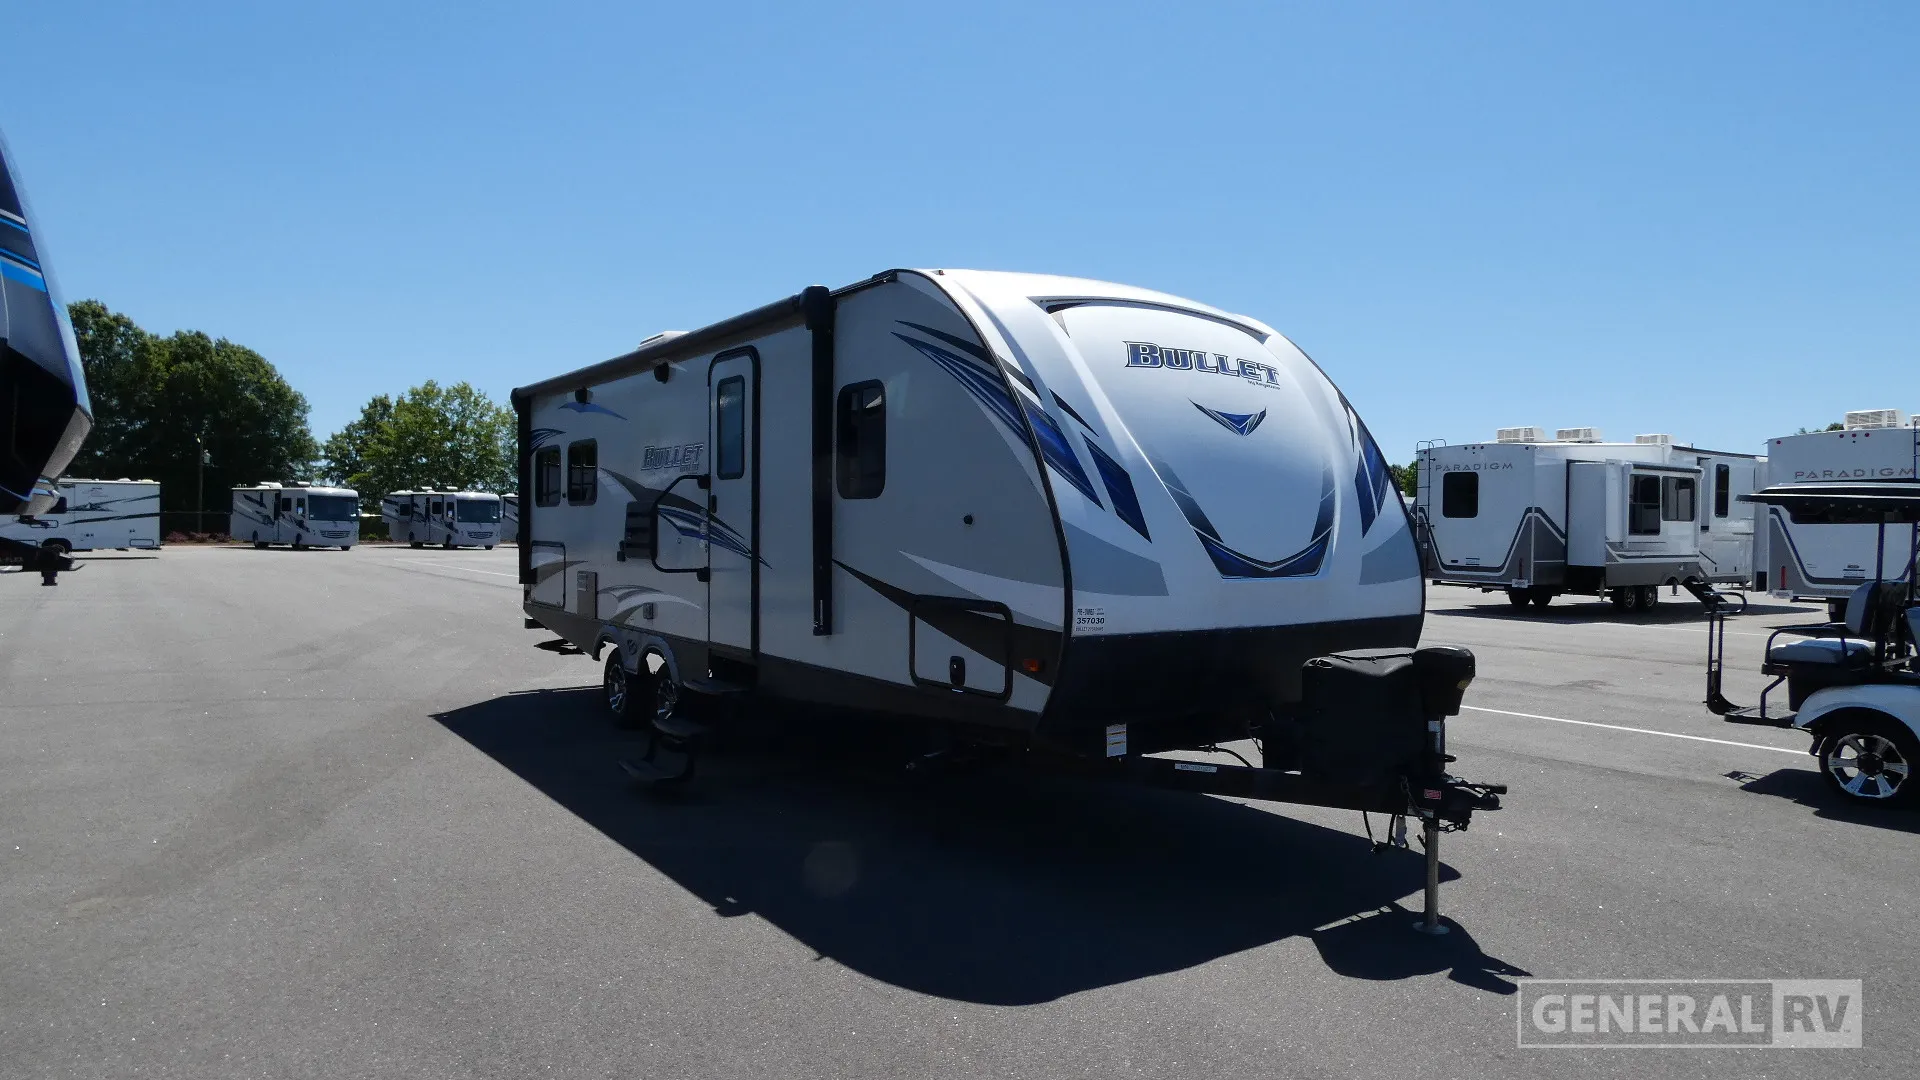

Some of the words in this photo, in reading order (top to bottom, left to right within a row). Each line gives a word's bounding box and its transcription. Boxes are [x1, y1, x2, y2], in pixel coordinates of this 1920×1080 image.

[1123, 340, 1280, 386] BULLET
[640, 443, 704, 471] BULLET
[1435, 462, 1514, 472] PARADIGM
[1794, 467, 1915, 479] PARADIGM
[1076, 617, 1105, 625] 357030
